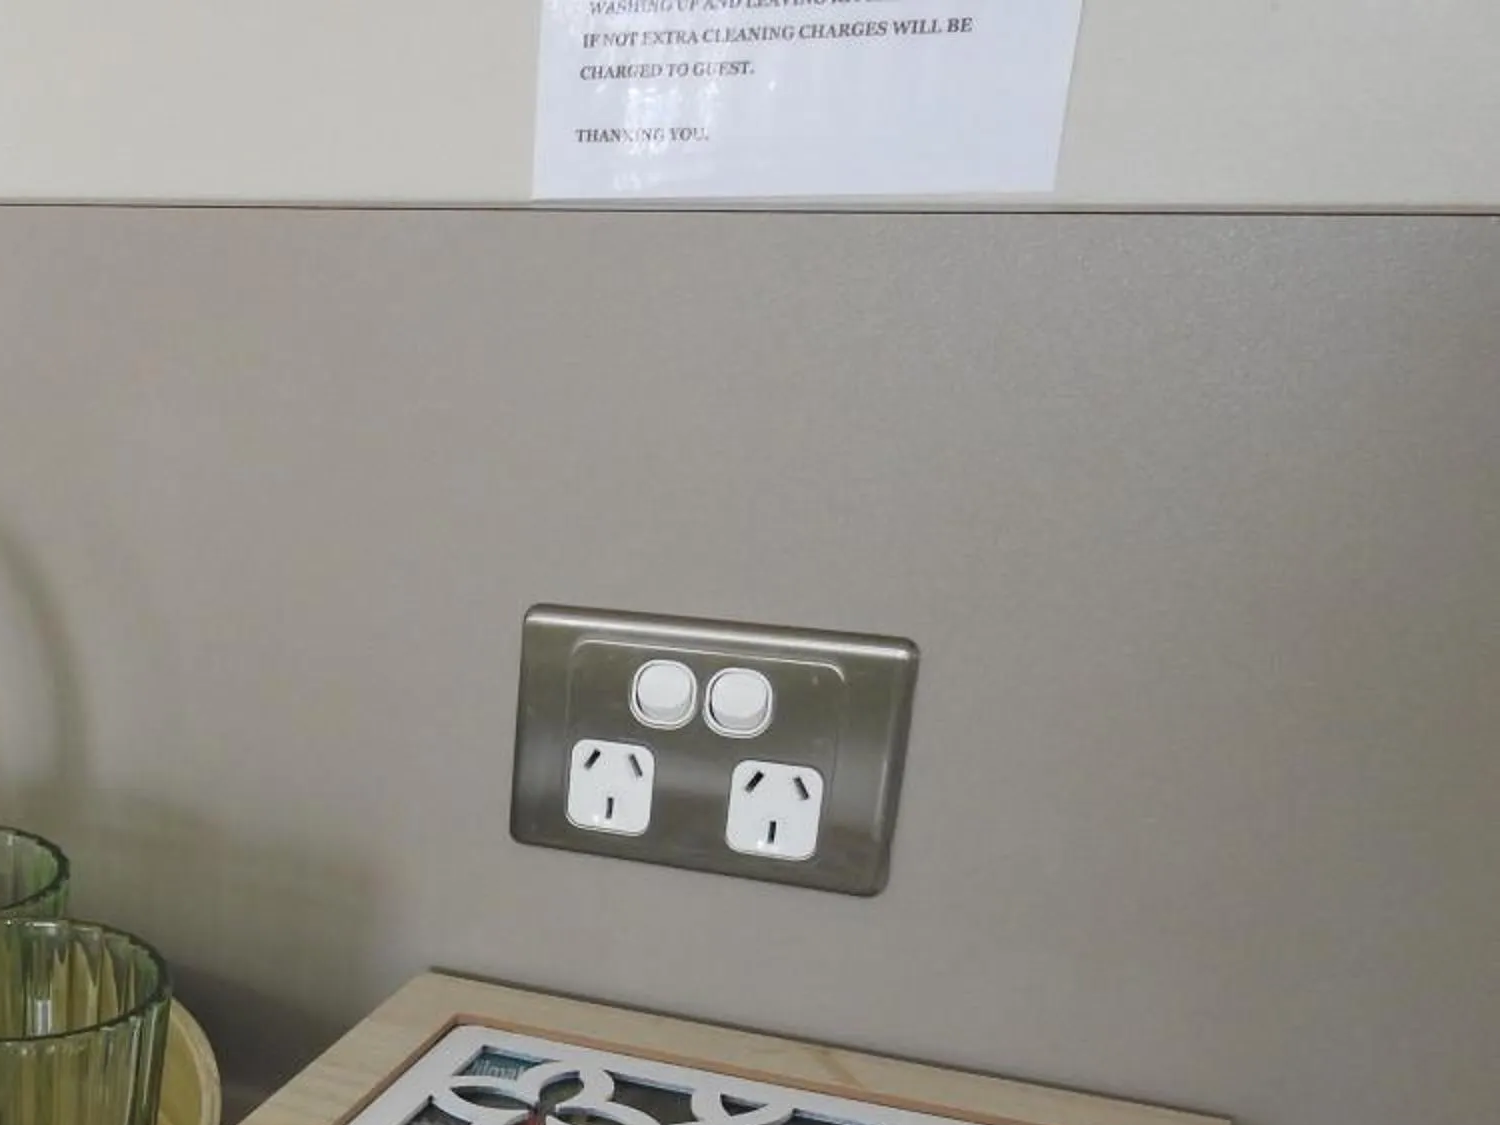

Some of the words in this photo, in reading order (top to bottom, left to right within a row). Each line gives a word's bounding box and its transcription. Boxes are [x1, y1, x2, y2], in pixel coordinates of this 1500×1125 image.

[583, 33, 600, 48] IF
[602, 31, 638, 47] NOT
[642, 29, 699, 46] EXTRA
[702, 24, 795, 43] CLEANING
[798, 20, 888, 39] CHARGES
[892, 18, 942, 35] WILL
[946, 17, 973, 33] BE
[579, 63, 663, 80] CHARGED
[667, 62, 689, 77] TO
